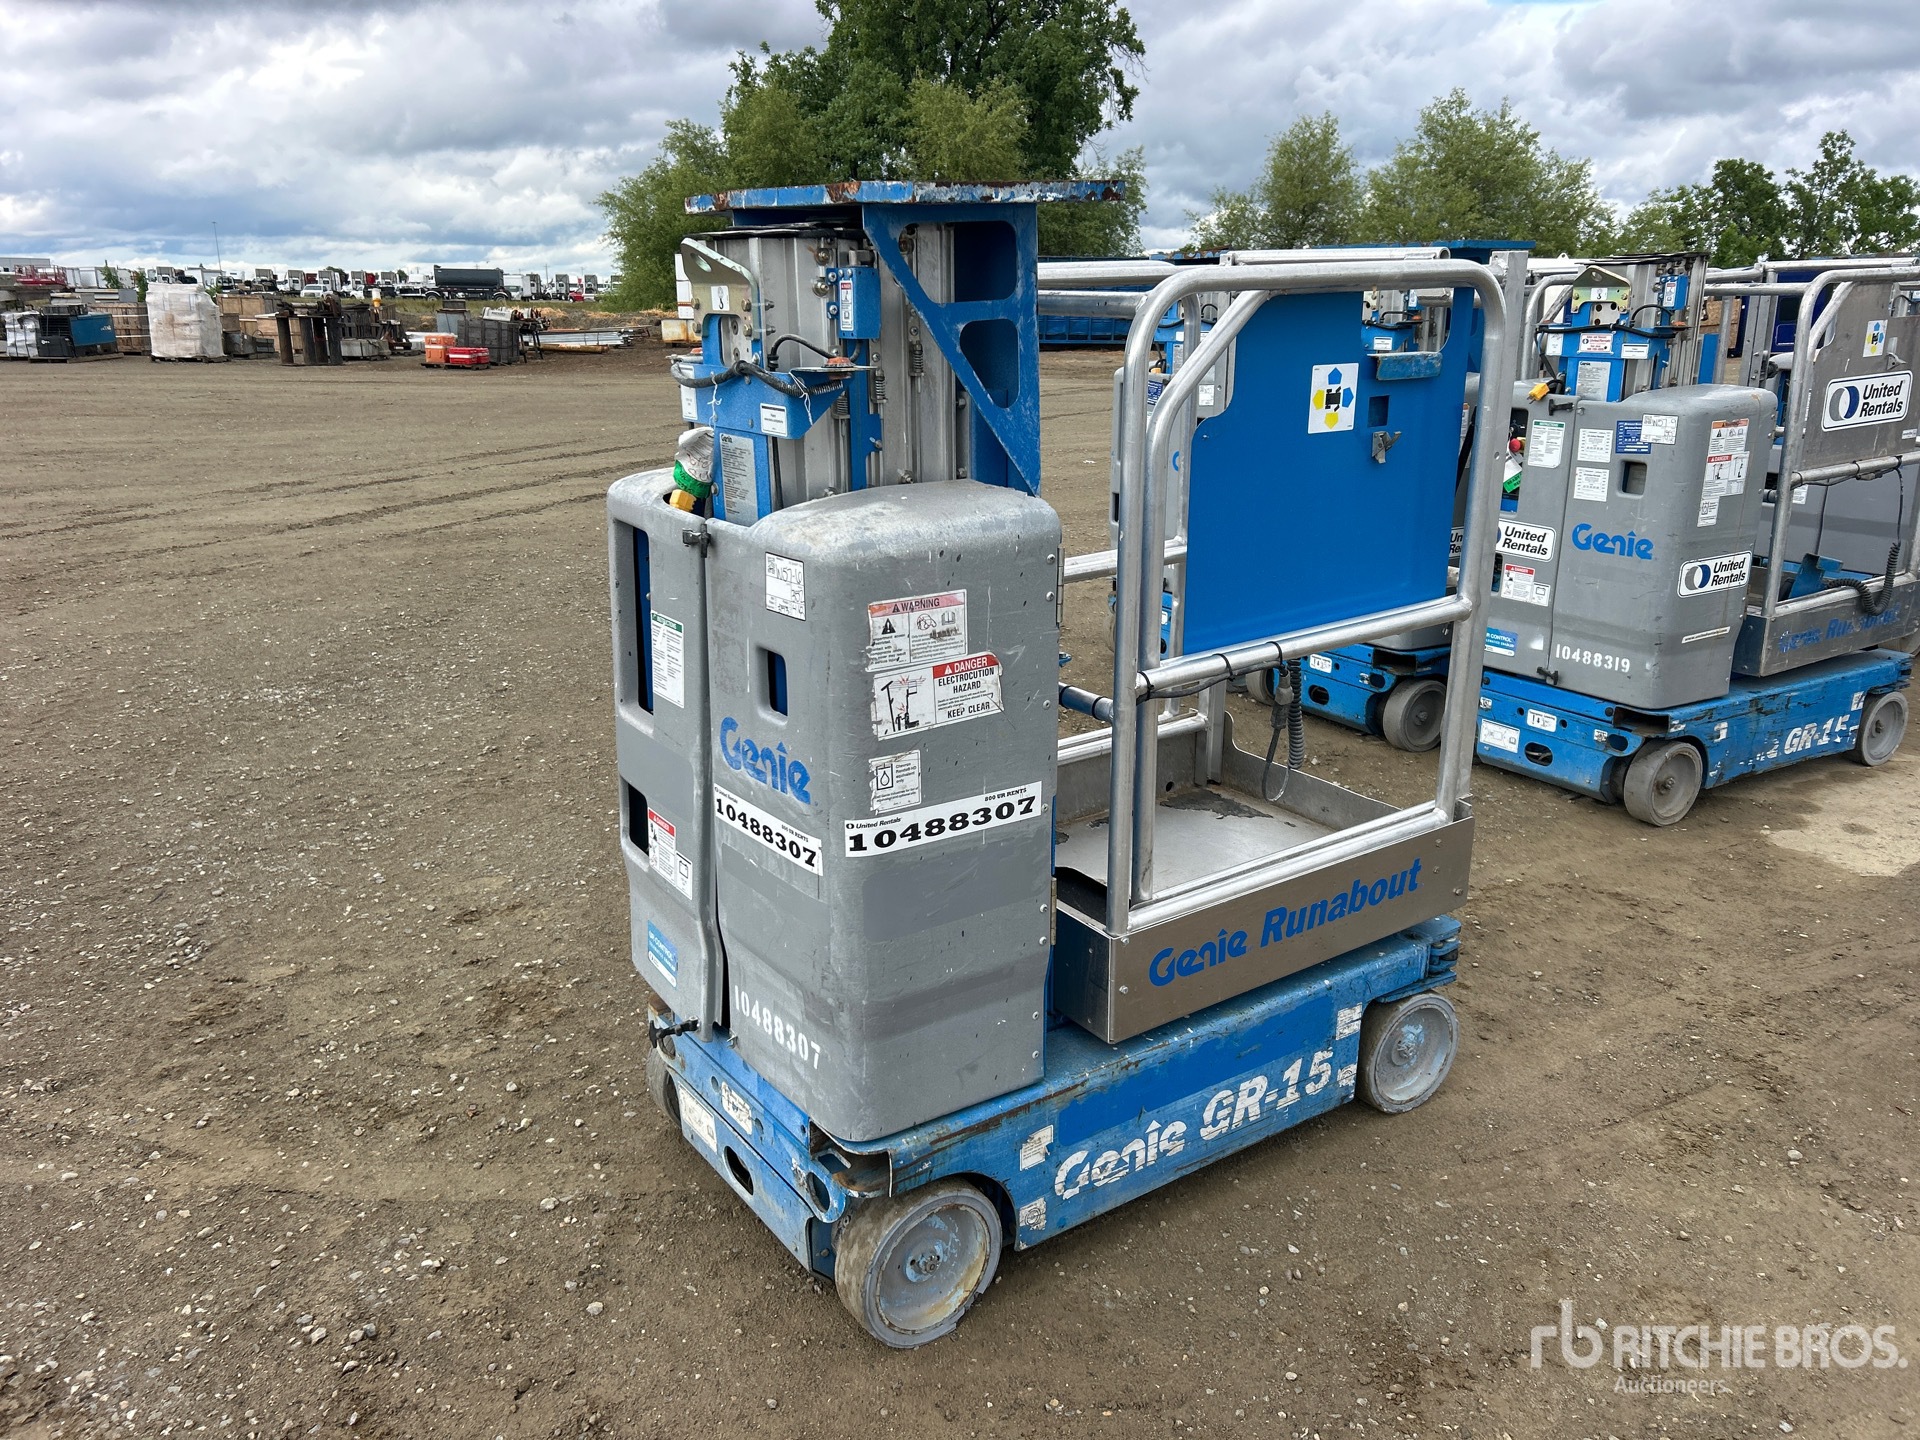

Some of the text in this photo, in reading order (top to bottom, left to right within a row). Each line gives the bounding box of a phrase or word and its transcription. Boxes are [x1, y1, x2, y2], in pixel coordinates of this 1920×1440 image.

[1863, 381, 1903, 400] United
[1859, 397, 1904, 418] Rentals
[1504, 526, 1547, 543] United
[1572, 523, 1654, 560] Genie
[1502, 538, 1548, 556] Rentals
[1713, 558, 1746, 575] United
[1711, 569, 1747, 586] Rentals
[900, 597, 941, 613] WARNING
[954, 656, 989, 673] DANGER
[1555, 644, 1631, 673] 10488319
[938, 667, 995, 687] ELECTROCUTION
[953, 680, 982, 694] HAZARD
[947, 701, 990, 718] KEEP CLEAR
[720, 716, 811, 805] Genie
[855, 787, 1027, 830] United Rentals 800 UR RENTS
[656, 817, 671, 833] DANGER
[716, 798, 817, 867] 10488307
[849, 795, 1036, 852] 10488307
[1149, 858, 1422, 987] Genie Runabout
[734, 985, 821, 1069] 10488307
[1054, 1048, 1334, 1201] Genie GR-15
